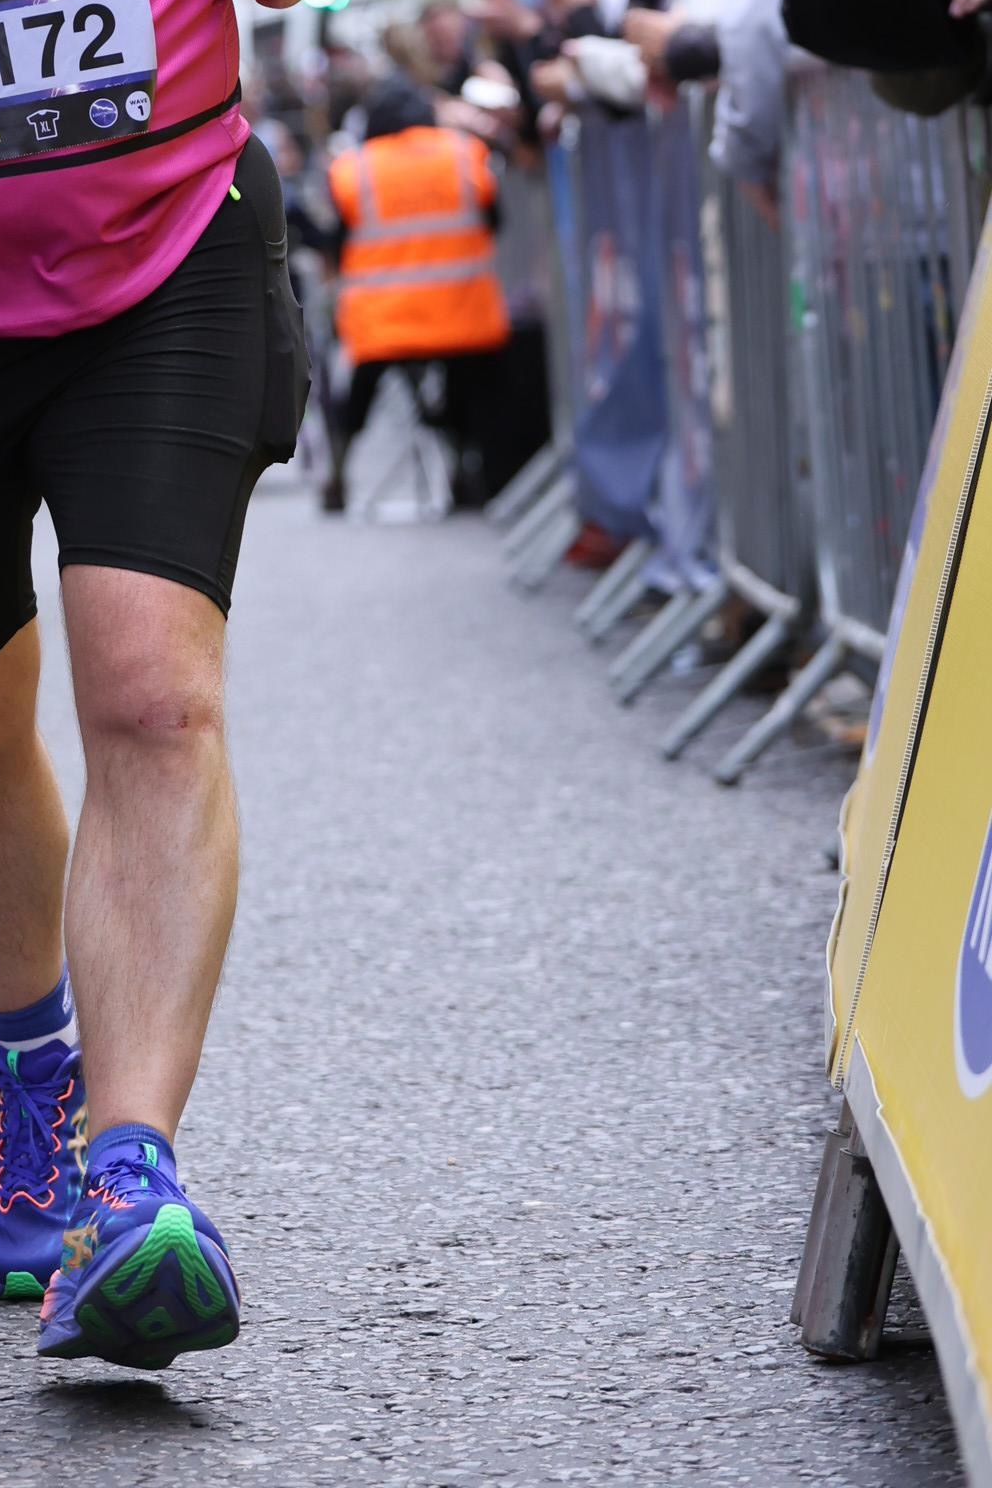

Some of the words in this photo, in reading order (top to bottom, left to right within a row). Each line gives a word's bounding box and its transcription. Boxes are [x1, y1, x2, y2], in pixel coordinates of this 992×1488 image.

[129, 97, 148, 105] WAVE
[137, 105, 144, 116] 1
[39, 120, 51, 133] XL
